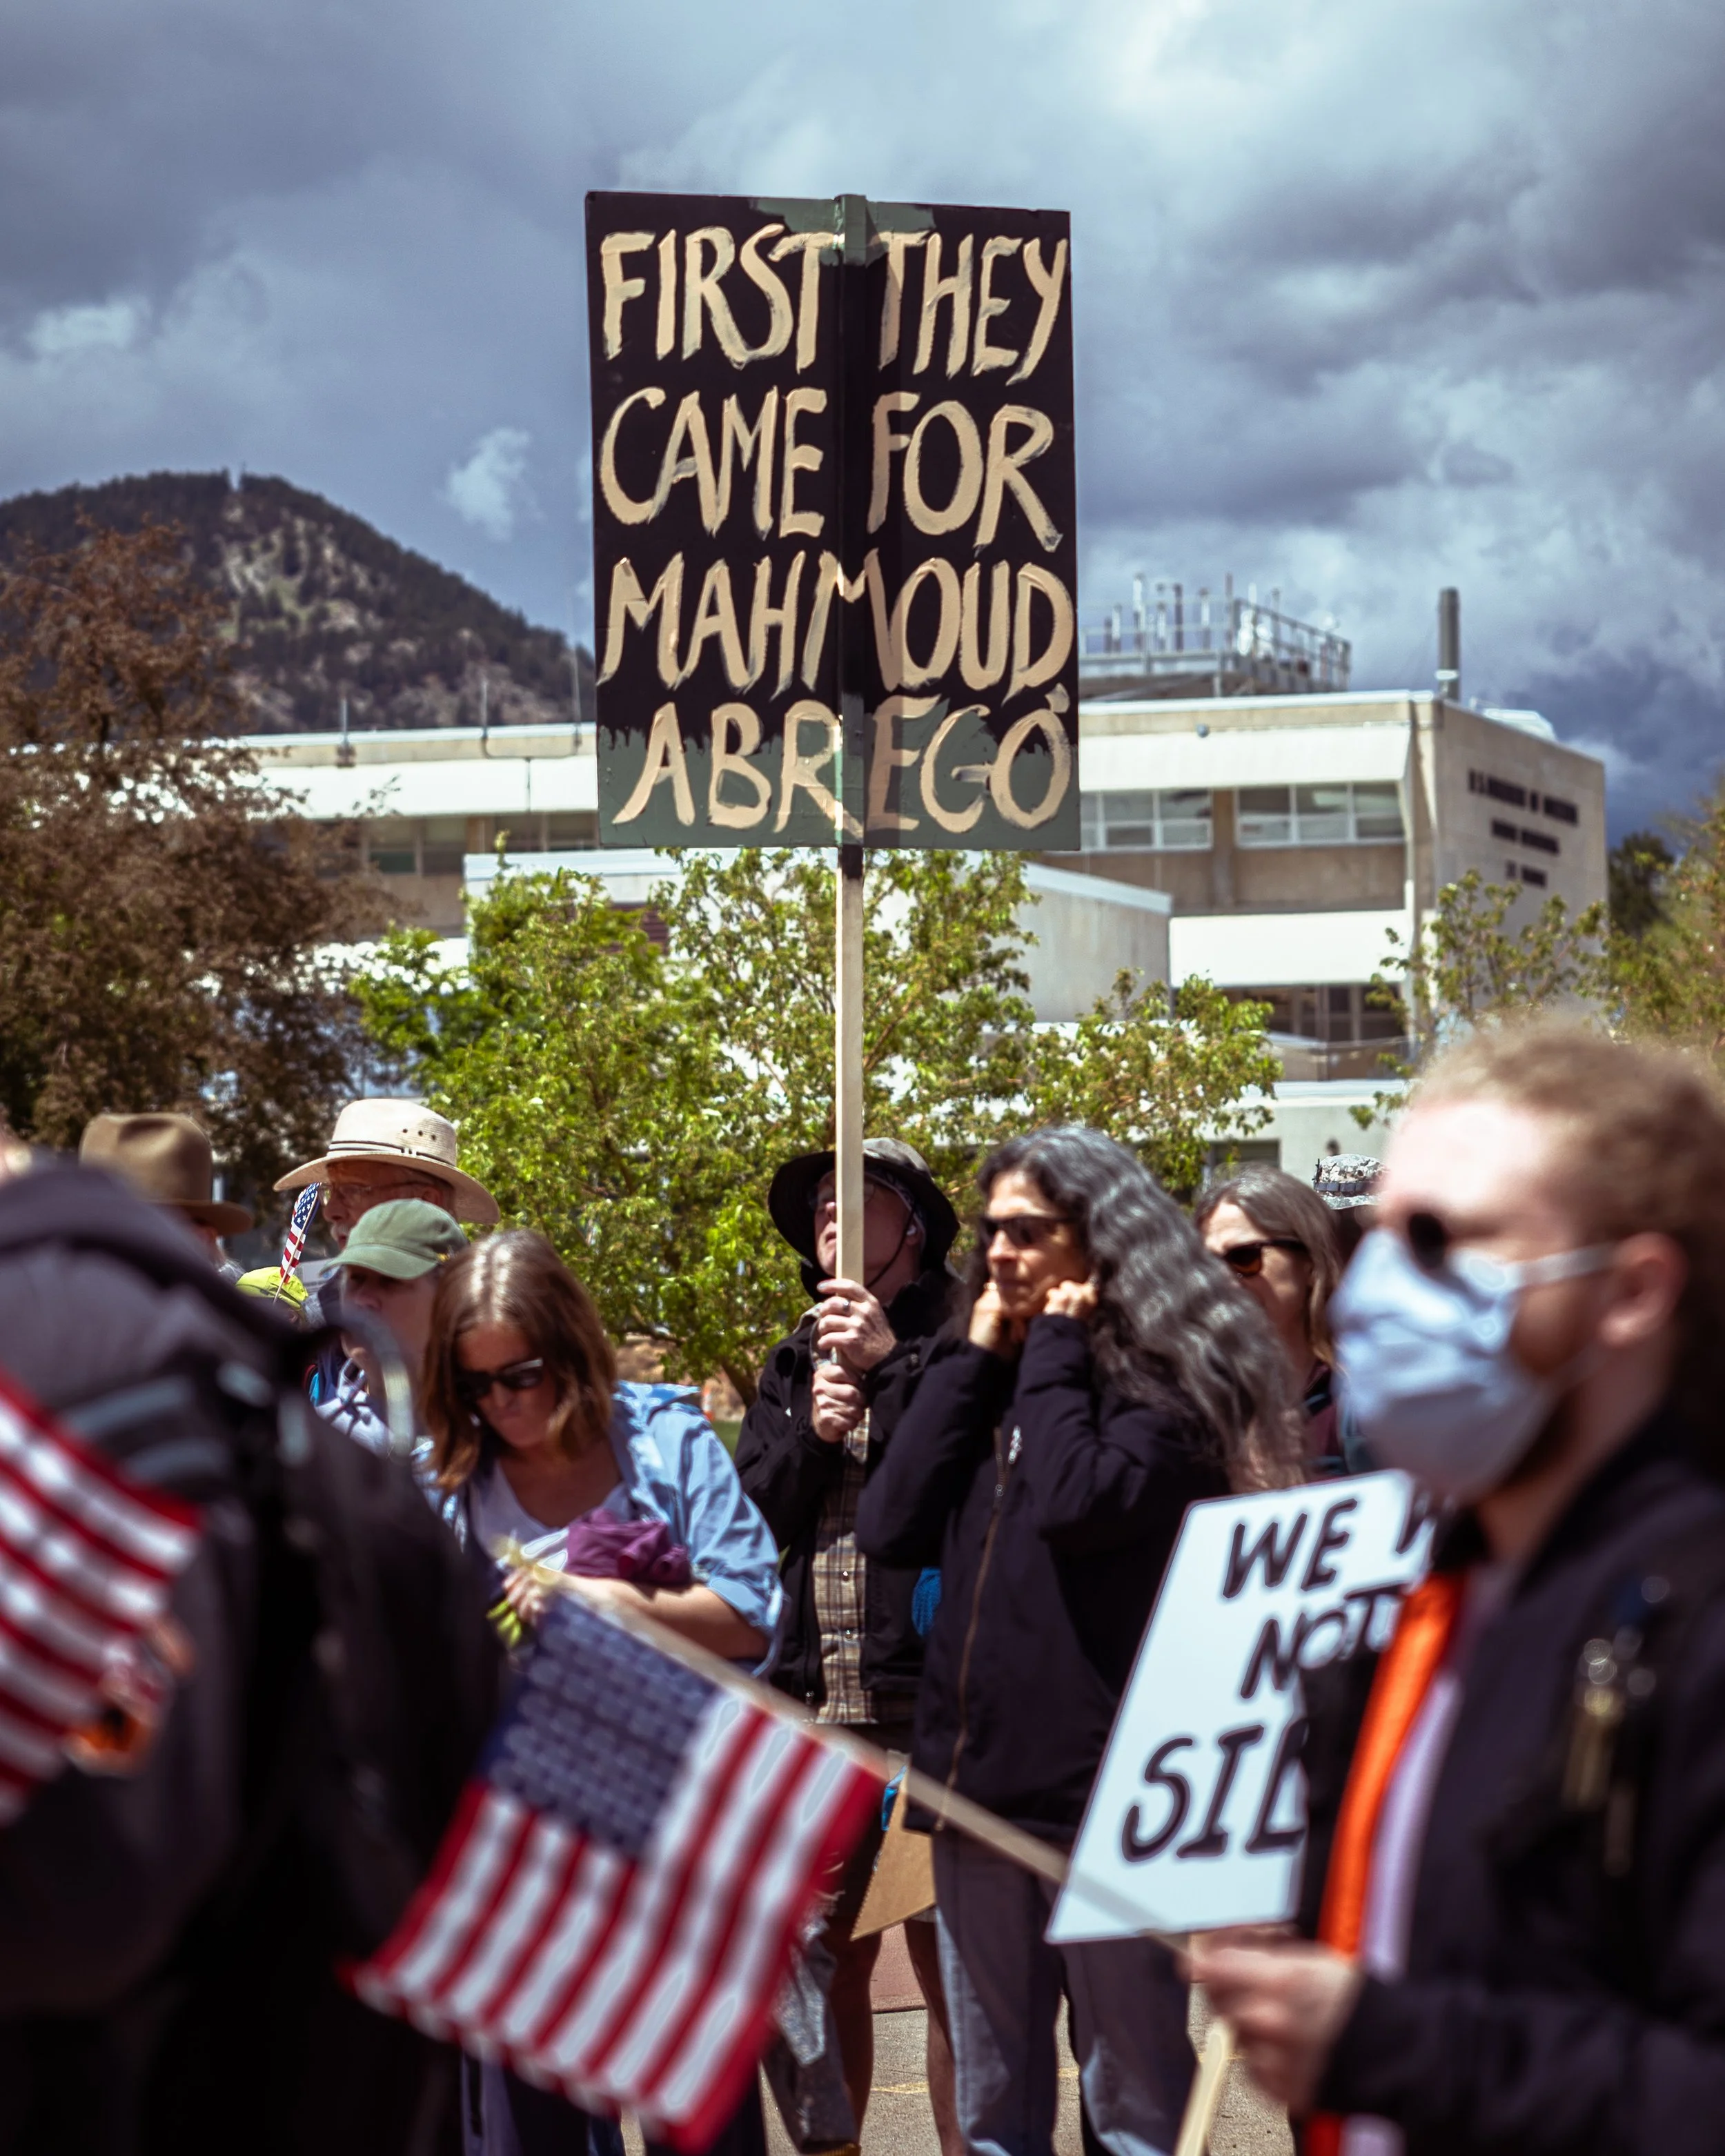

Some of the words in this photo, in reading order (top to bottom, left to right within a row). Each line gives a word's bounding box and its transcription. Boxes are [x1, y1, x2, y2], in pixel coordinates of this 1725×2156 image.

[600, 224, 845, 374] FIRST
[868, 230, 1069, 386] THEY
[600, 386, 827, 541] CAME
[867, 391, 1063, 554] FOR
[1223, 1498, 1358, 1599] WE
[1241, 1582, 1408, 1699] NOT
[1121, 1718, 1308, 1863] SIL
